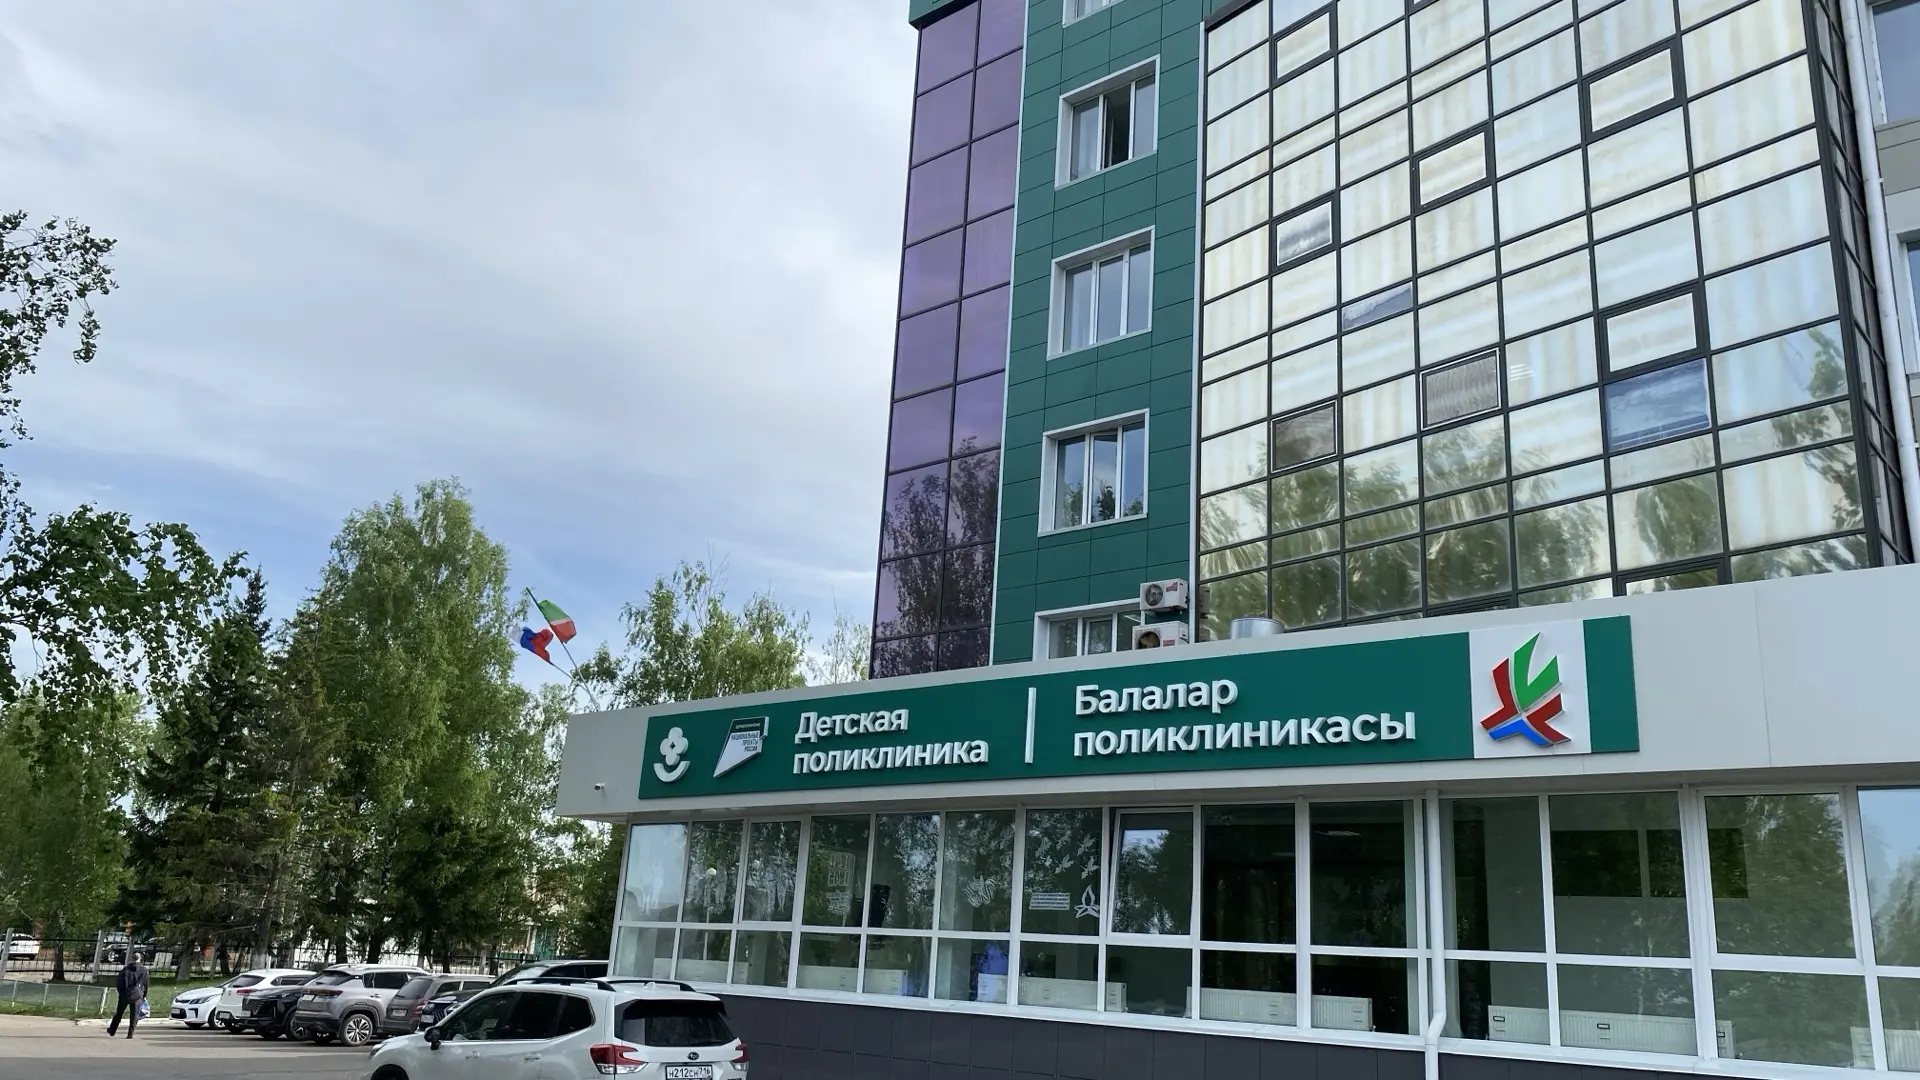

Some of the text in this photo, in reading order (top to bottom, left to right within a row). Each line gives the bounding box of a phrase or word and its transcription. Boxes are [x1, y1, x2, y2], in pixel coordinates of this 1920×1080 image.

[1075, 679, 1238, 715] Балалар
[794, 709, 909, 744] Детская
[1073, 711, 1416, 757] поликлиникасы
[793, 739, 989, 774] поликлиника
